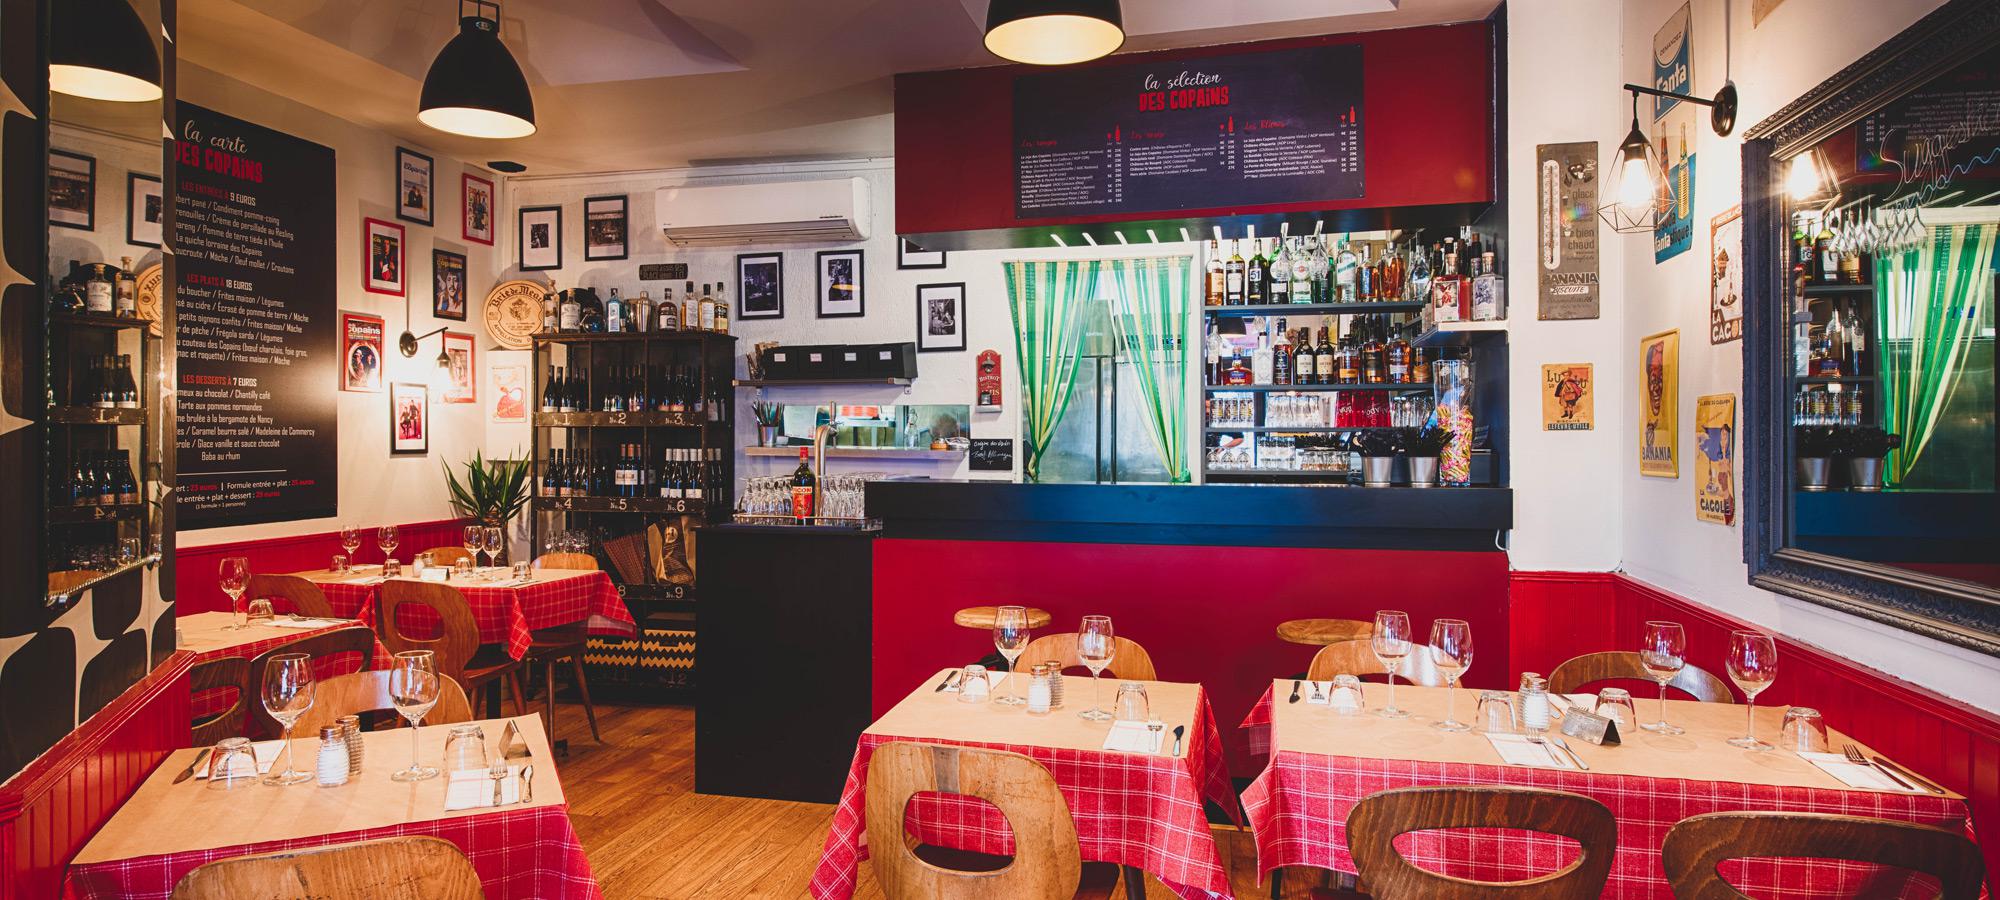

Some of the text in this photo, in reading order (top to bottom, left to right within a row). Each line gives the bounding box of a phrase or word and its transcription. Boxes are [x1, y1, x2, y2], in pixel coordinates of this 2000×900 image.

[1144, 70, 1222, 90] la sélection
[1656, 62, 1686, 111] Fanta
[1138, 92, 1165, 112] DES
[184, 120, 248, 154] la carte
[230, 192, 234, 201] 9
[236, 193, 256, 206] EUROS
[176, 209, 206, 220] renouilles
[1568, 240, 1594, 250] chaud
[176, 248, 203, 258] oucroute
[1250, 270, 1260, 280] 51
[177, 284, 185, 294] du
[186, 285, 211, 298] boucher
[234, 280, 252, 291] EUROS
[488, 290, 510, 308] Brie
[519, 286, 543, 304] Meau
[195, 300, 210, 310] cidre
[179, 313, 196, 322] petits
[198, 314, 221, 325] oignons
[1712, 320, 1742, 342] CAGOL
[182, 340, 206, 348] couteau
[208, 339, 218, 349] des
[220, 340, 241, 351] Copains
[183, 374, 195, 384] LES
[195, 375, 227, 385] DESSERTS
[233, 378, 237, 386] 7
[238, 378, 257, 387] EUROS
[204, 388, 228, 398] chocolat
[234, 389, 258, 400] Chantilly
[178, 400, 194, 410] Tarte
[212, 414, 217, 422] la
[219, 414, 248, 425] bergamote
[257, 414, 273, 425] Nancy
[192, 426, 217, 436] Caramel
[217, 426, 237, 436] beurre
[198, 439, 213, 448] Glace
[215, 439, 233, 448] vanille
[258, 439, 280, 447] chocolat
[201, 452, 216, 461] Baba
[226, 452, 240, 460] rhum
[1642, 447, 1672, 460] BANANIA
[277, 480, 288, 488] plat
[211, 493, 223, 502] plat
